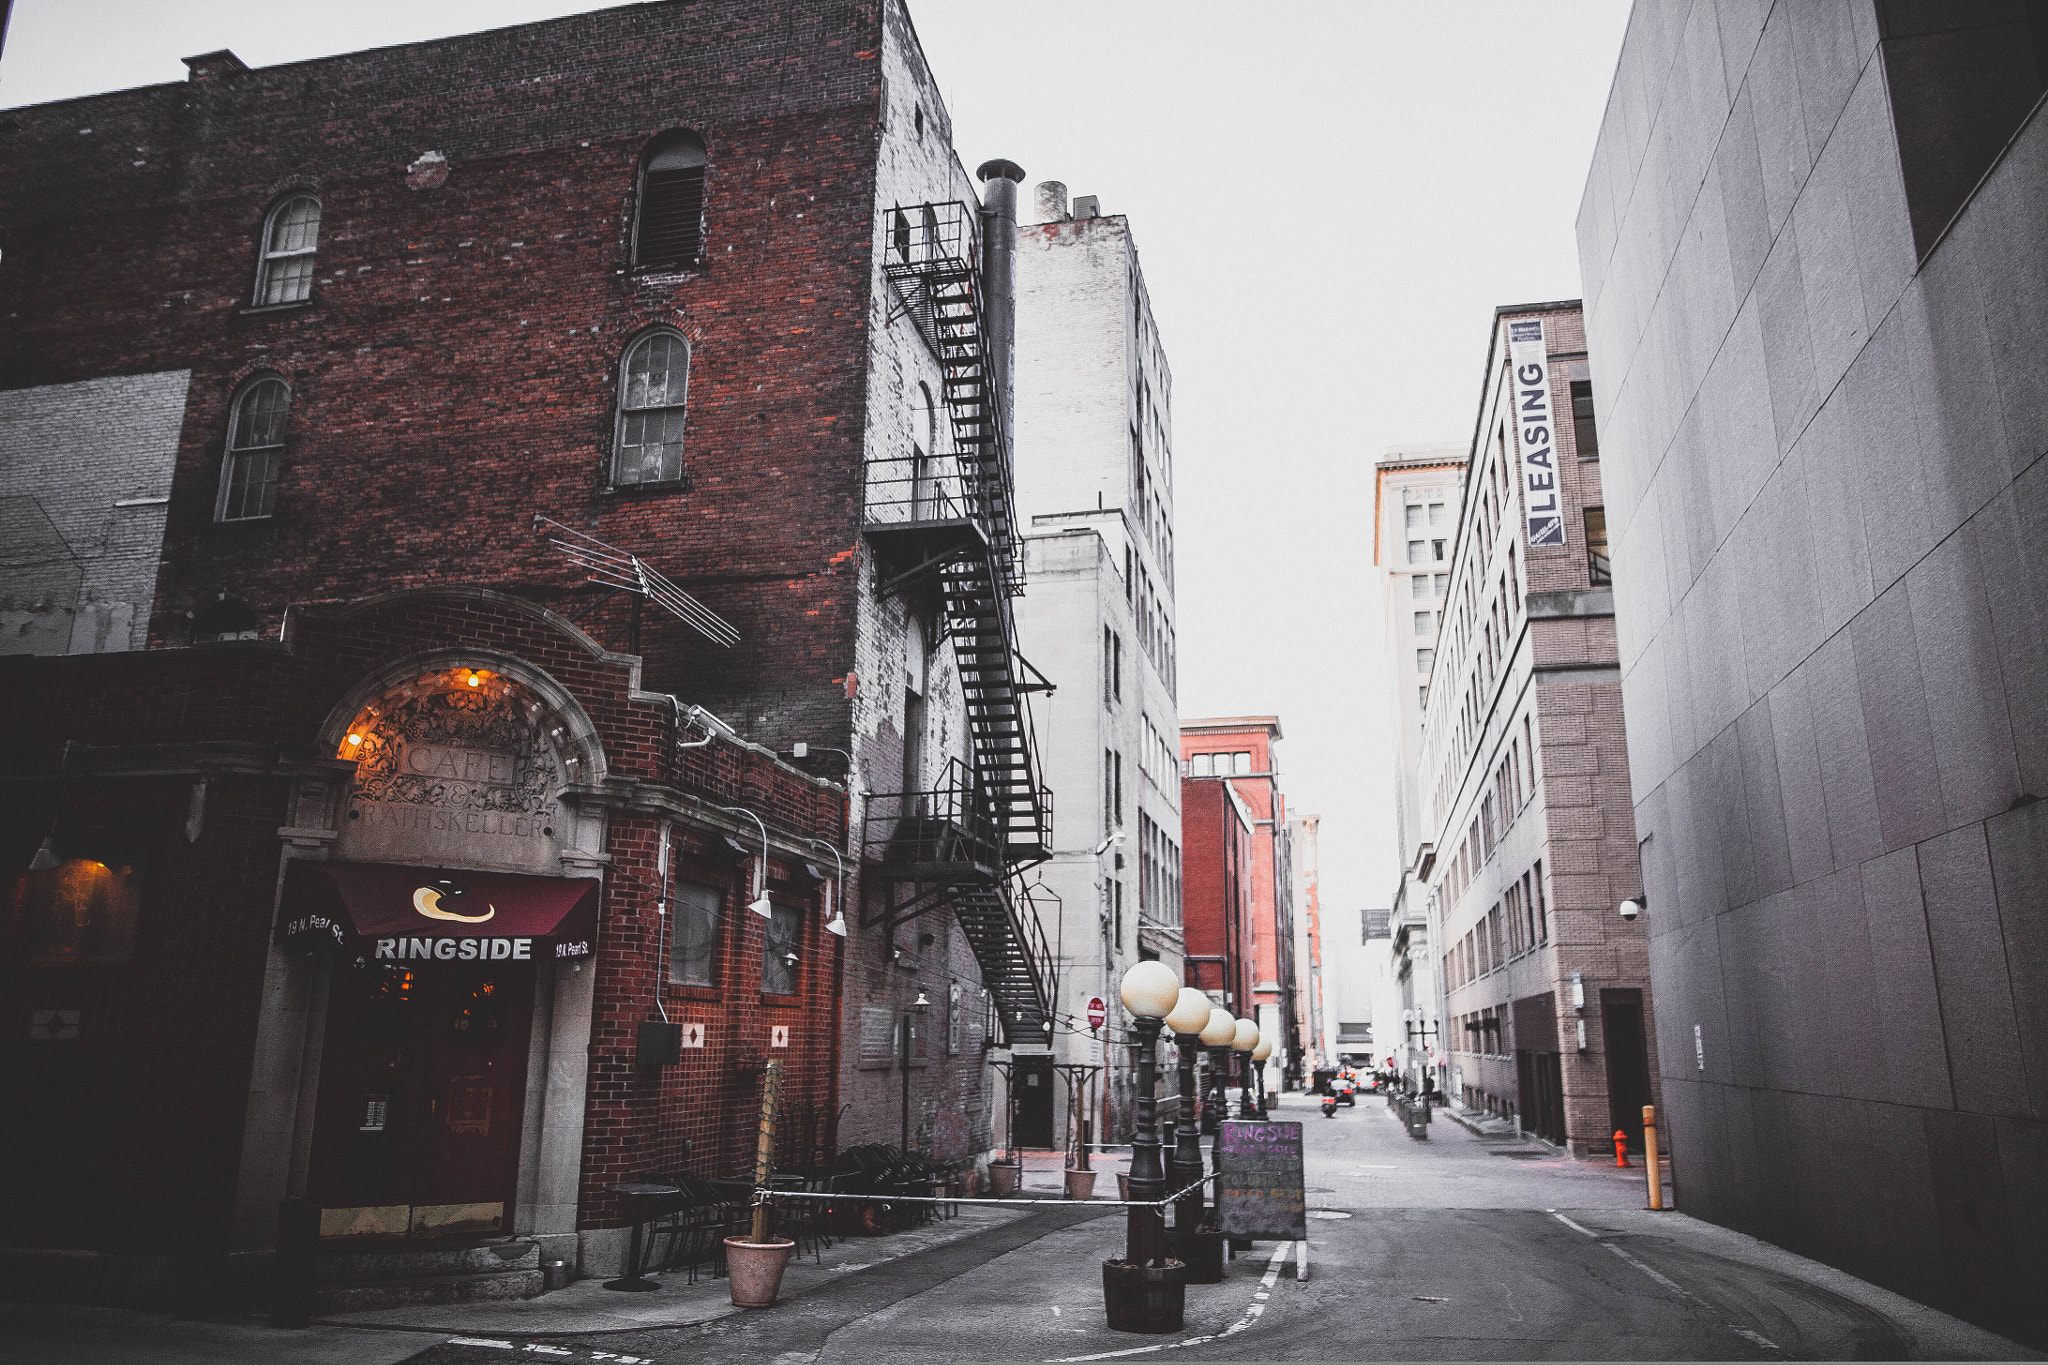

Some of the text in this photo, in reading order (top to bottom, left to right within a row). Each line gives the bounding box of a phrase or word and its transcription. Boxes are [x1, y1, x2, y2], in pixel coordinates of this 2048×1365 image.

[1517, 362, 1557, 511] LEASING
[407, 744, 509, 783] CAFE
[452, 785, 466, 804] &
[360, 803, 544, 839] RATHSKELLER
[288, 920, 297, 936] 19
[332, 923, 344, 945] St.
[375, 937, 533, 961] RINGSIDE
[1224, 1122, 1301, 1144] RINGSIDE
